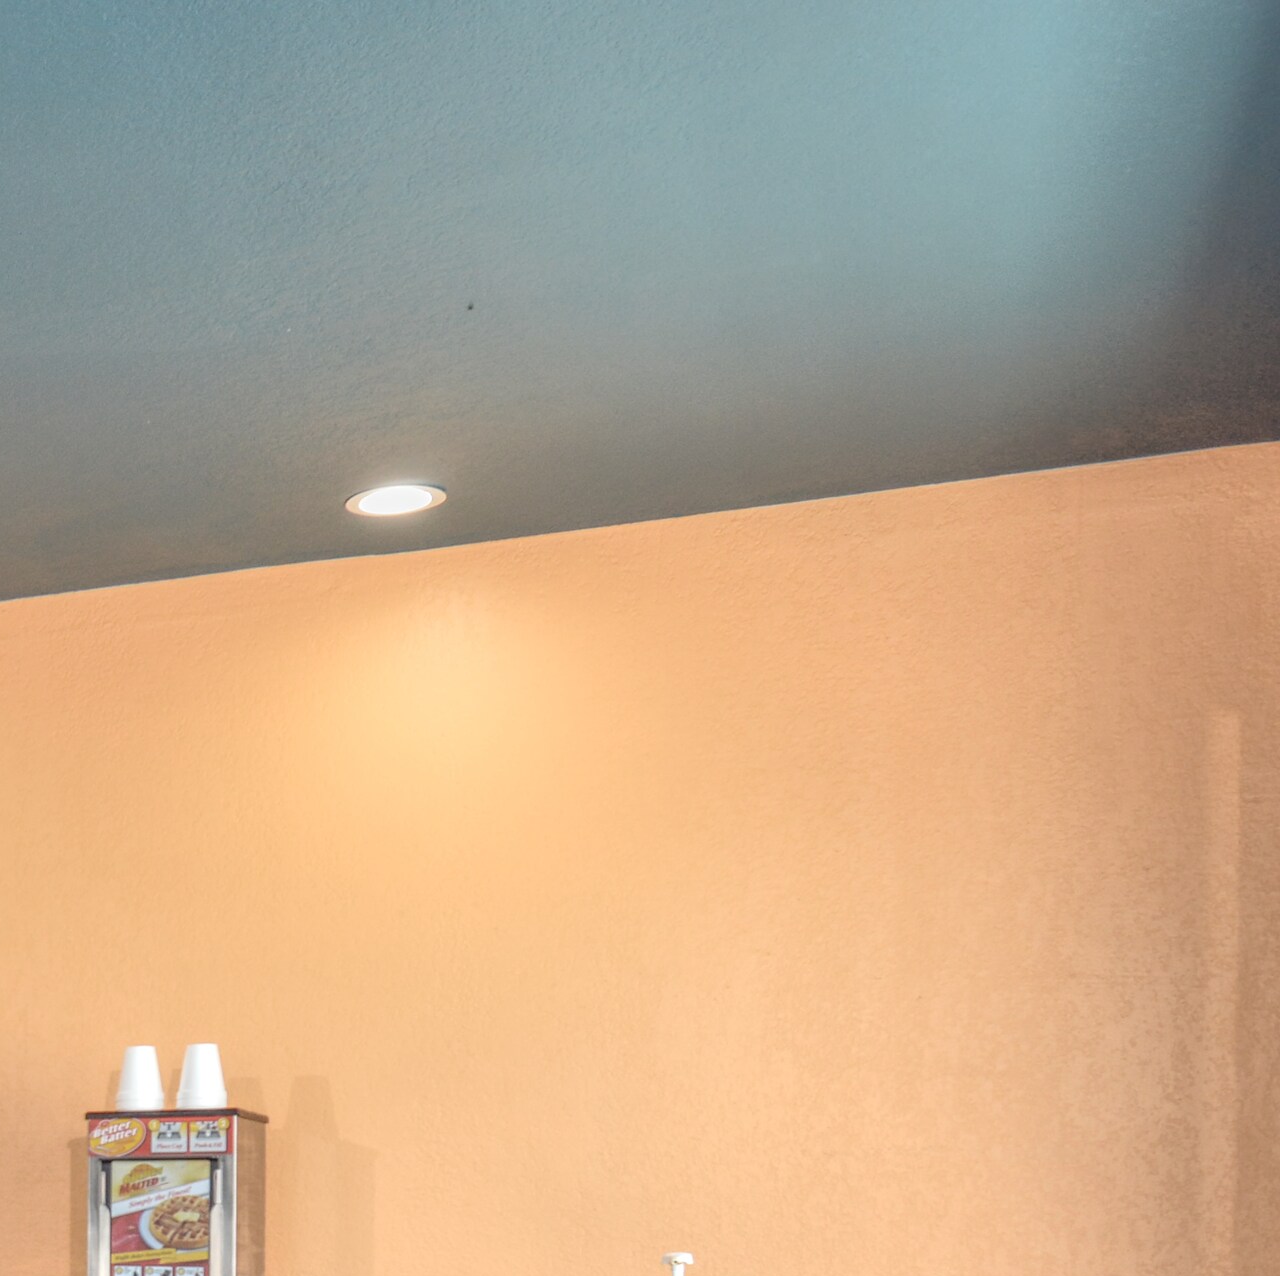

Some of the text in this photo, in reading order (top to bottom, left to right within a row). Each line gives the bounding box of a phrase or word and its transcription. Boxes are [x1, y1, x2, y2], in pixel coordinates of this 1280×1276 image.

[93, 1120, 132, 1139] Better
[100, 1127, 138, 1145] Batter
[119, 1177, 159, 1197] MALTED
